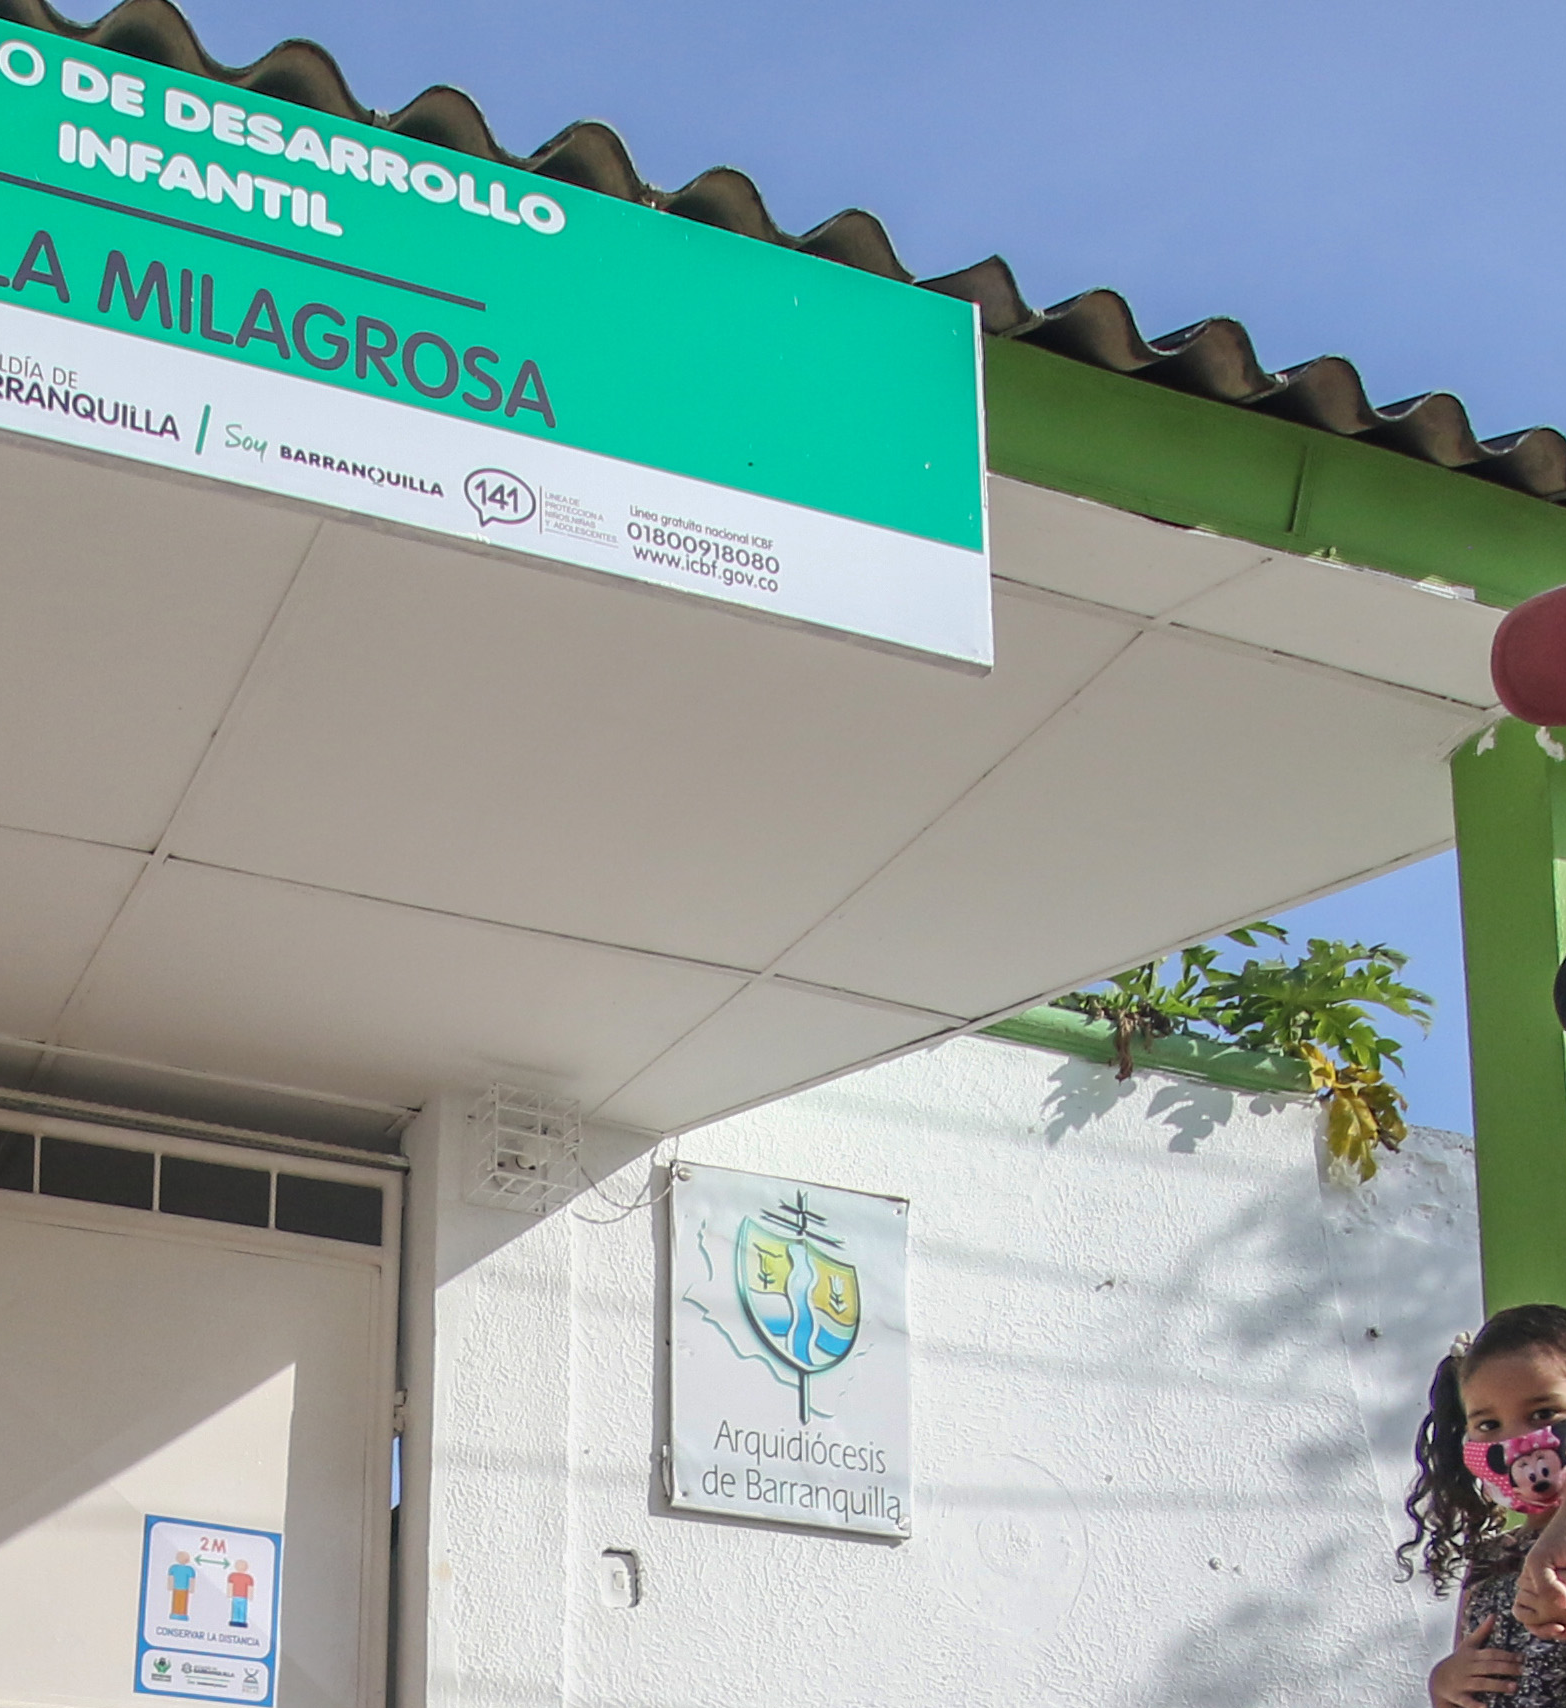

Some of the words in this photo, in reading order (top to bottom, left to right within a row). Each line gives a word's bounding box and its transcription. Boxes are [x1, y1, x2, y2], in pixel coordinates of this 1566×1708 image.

[59, 58, 146, 118] DE
[163, 87, 567, 236] DESARROLLO
[58, 122, 343, 238] INFANTIL
[96, 249, 557, 430] MILAGROSA
[52, 365, 79, 390] DE
[224, 423, 269, 463] Soy
[279, 444, 445, 498] BARRANQUILLA
[474, 478, 519, 514] 141
[626, 521, 780, 575] 01800918080
[660, 512, 703, 534] gratuita
[705, 523, 750, 546] nacional
[751, 534, 774, 551] ICBF
[632, 545, 779, 593] www.icbf.gov.co
[713, 1418, 887, 1475] Arquidiócesis
[701, 1464, 736, 1499] de
[745, 1468, 902, 1524] Barranquilla
[199, 1536, 210, 1551] 2
[211, 1538, 227, 1554] M
[155, 1625, 205, 1641] CONSERVAR
[206, 1631, 217, 1642] LA
[218, 1632, 261, 1647] DISTANCIA
